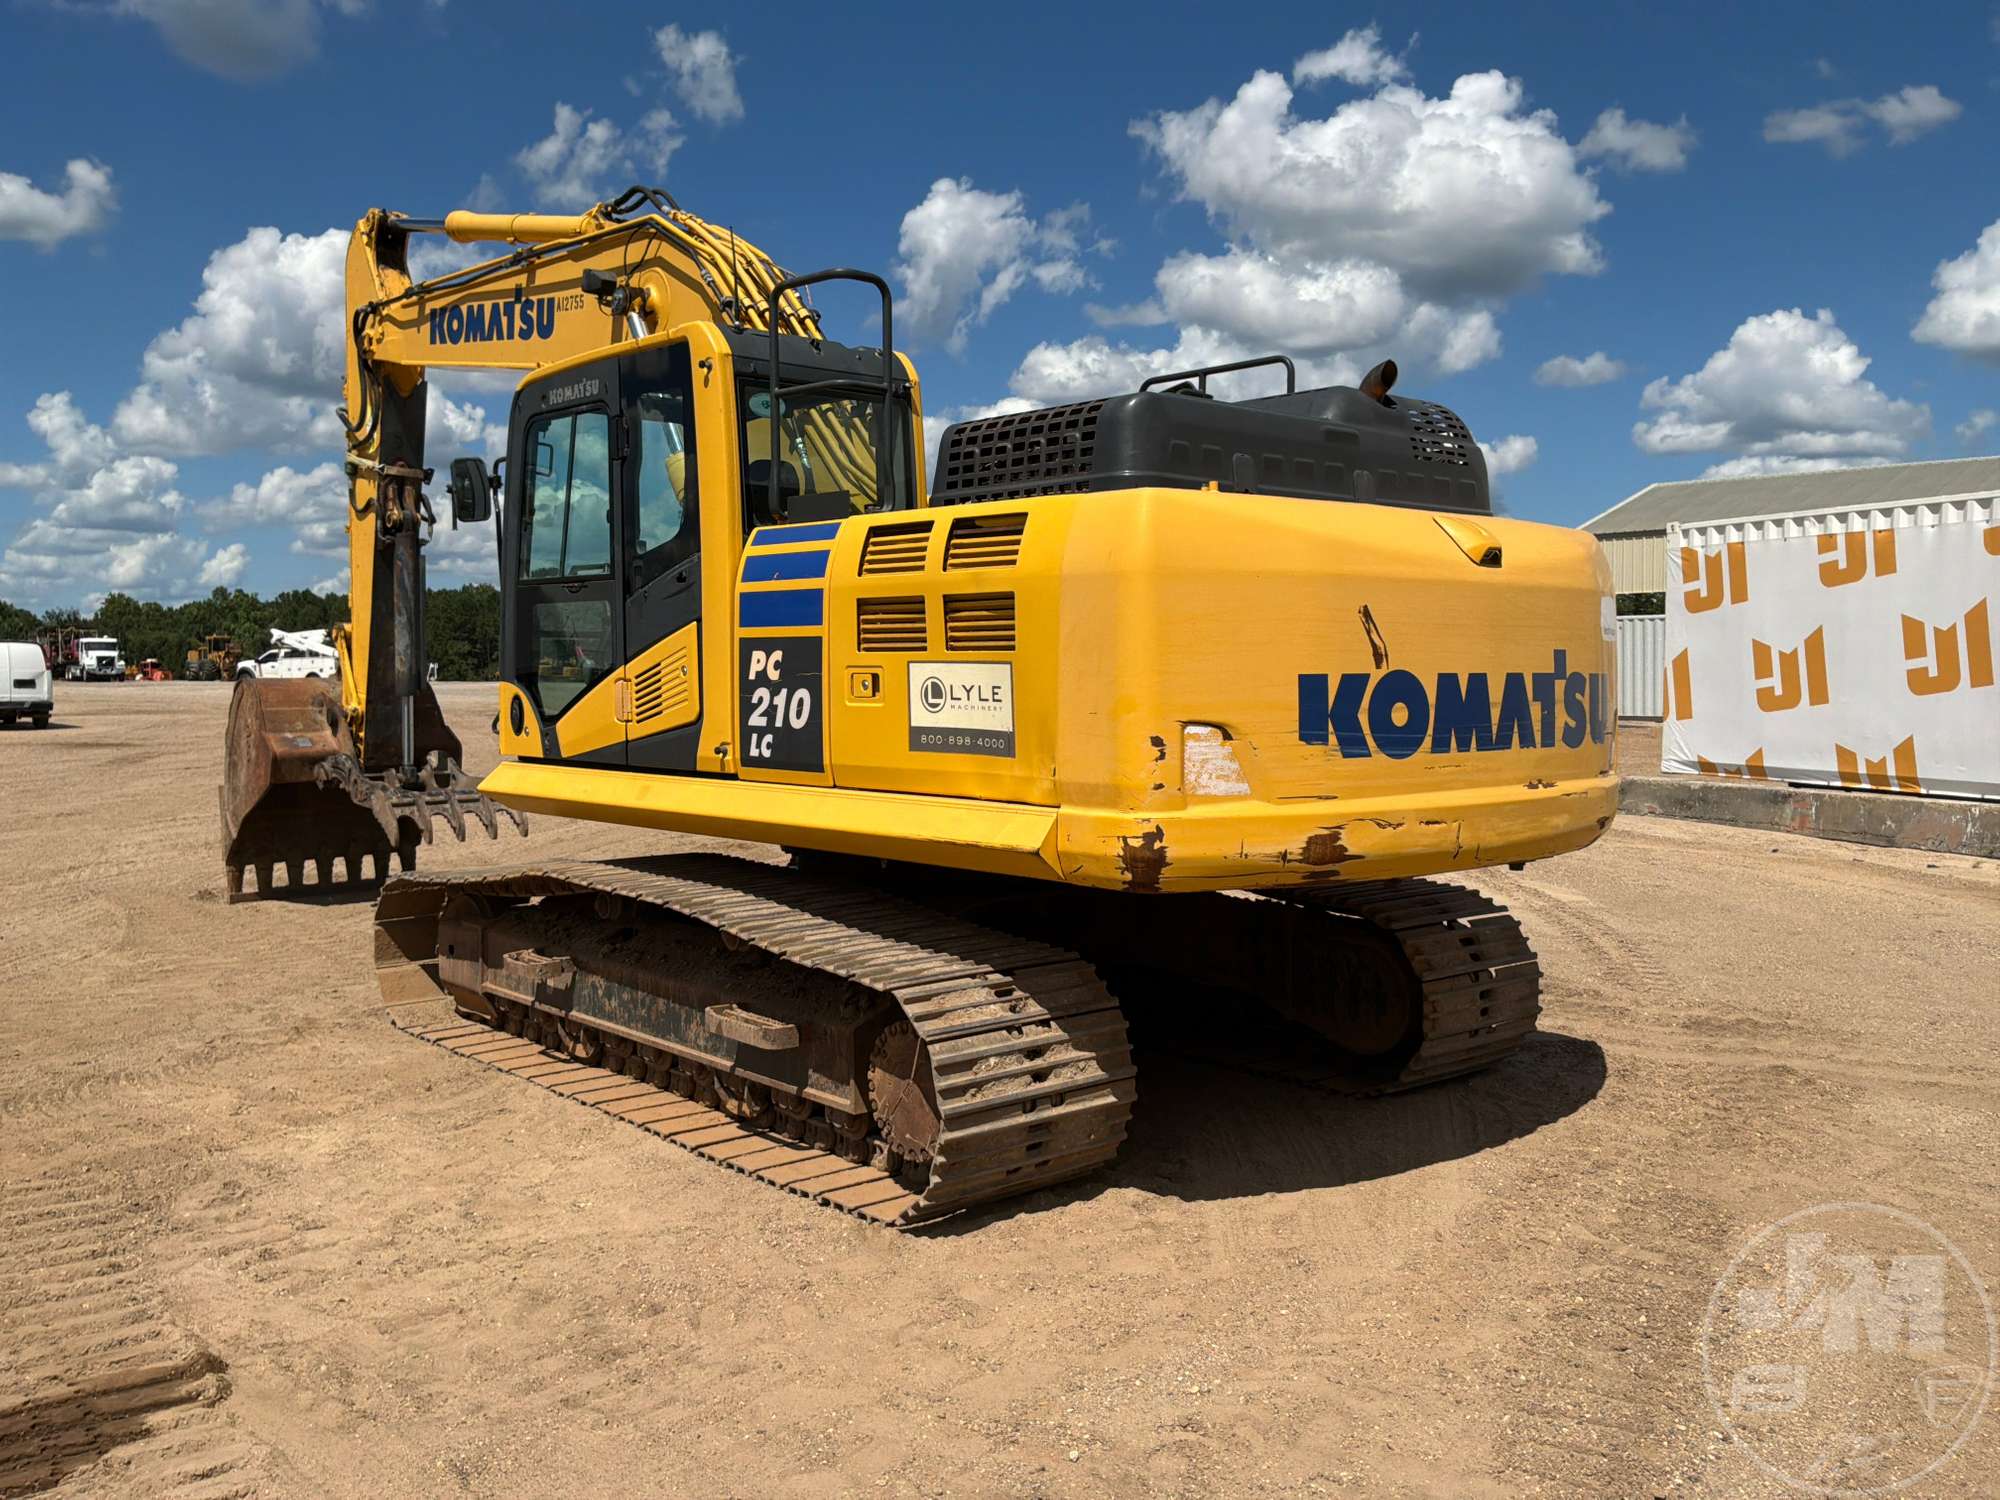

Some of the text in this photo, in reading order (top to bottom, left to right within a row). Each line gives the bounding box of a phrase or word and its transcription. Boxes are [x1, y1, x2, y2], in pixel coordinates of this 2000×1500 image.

[429, 284, 555, 345] KOMATSU
[549, 378, 600, 405] KOMATSU
[748, 650, 784, 681] PC
[950, 684, 1002, 702] LYLE
[1298, 649, 1608, 759] KOMATSU
[748, 687, 811, 730] 210
[950, 704, 1003, 712] MACHINERY
[749, 733, 773, 759] LC
